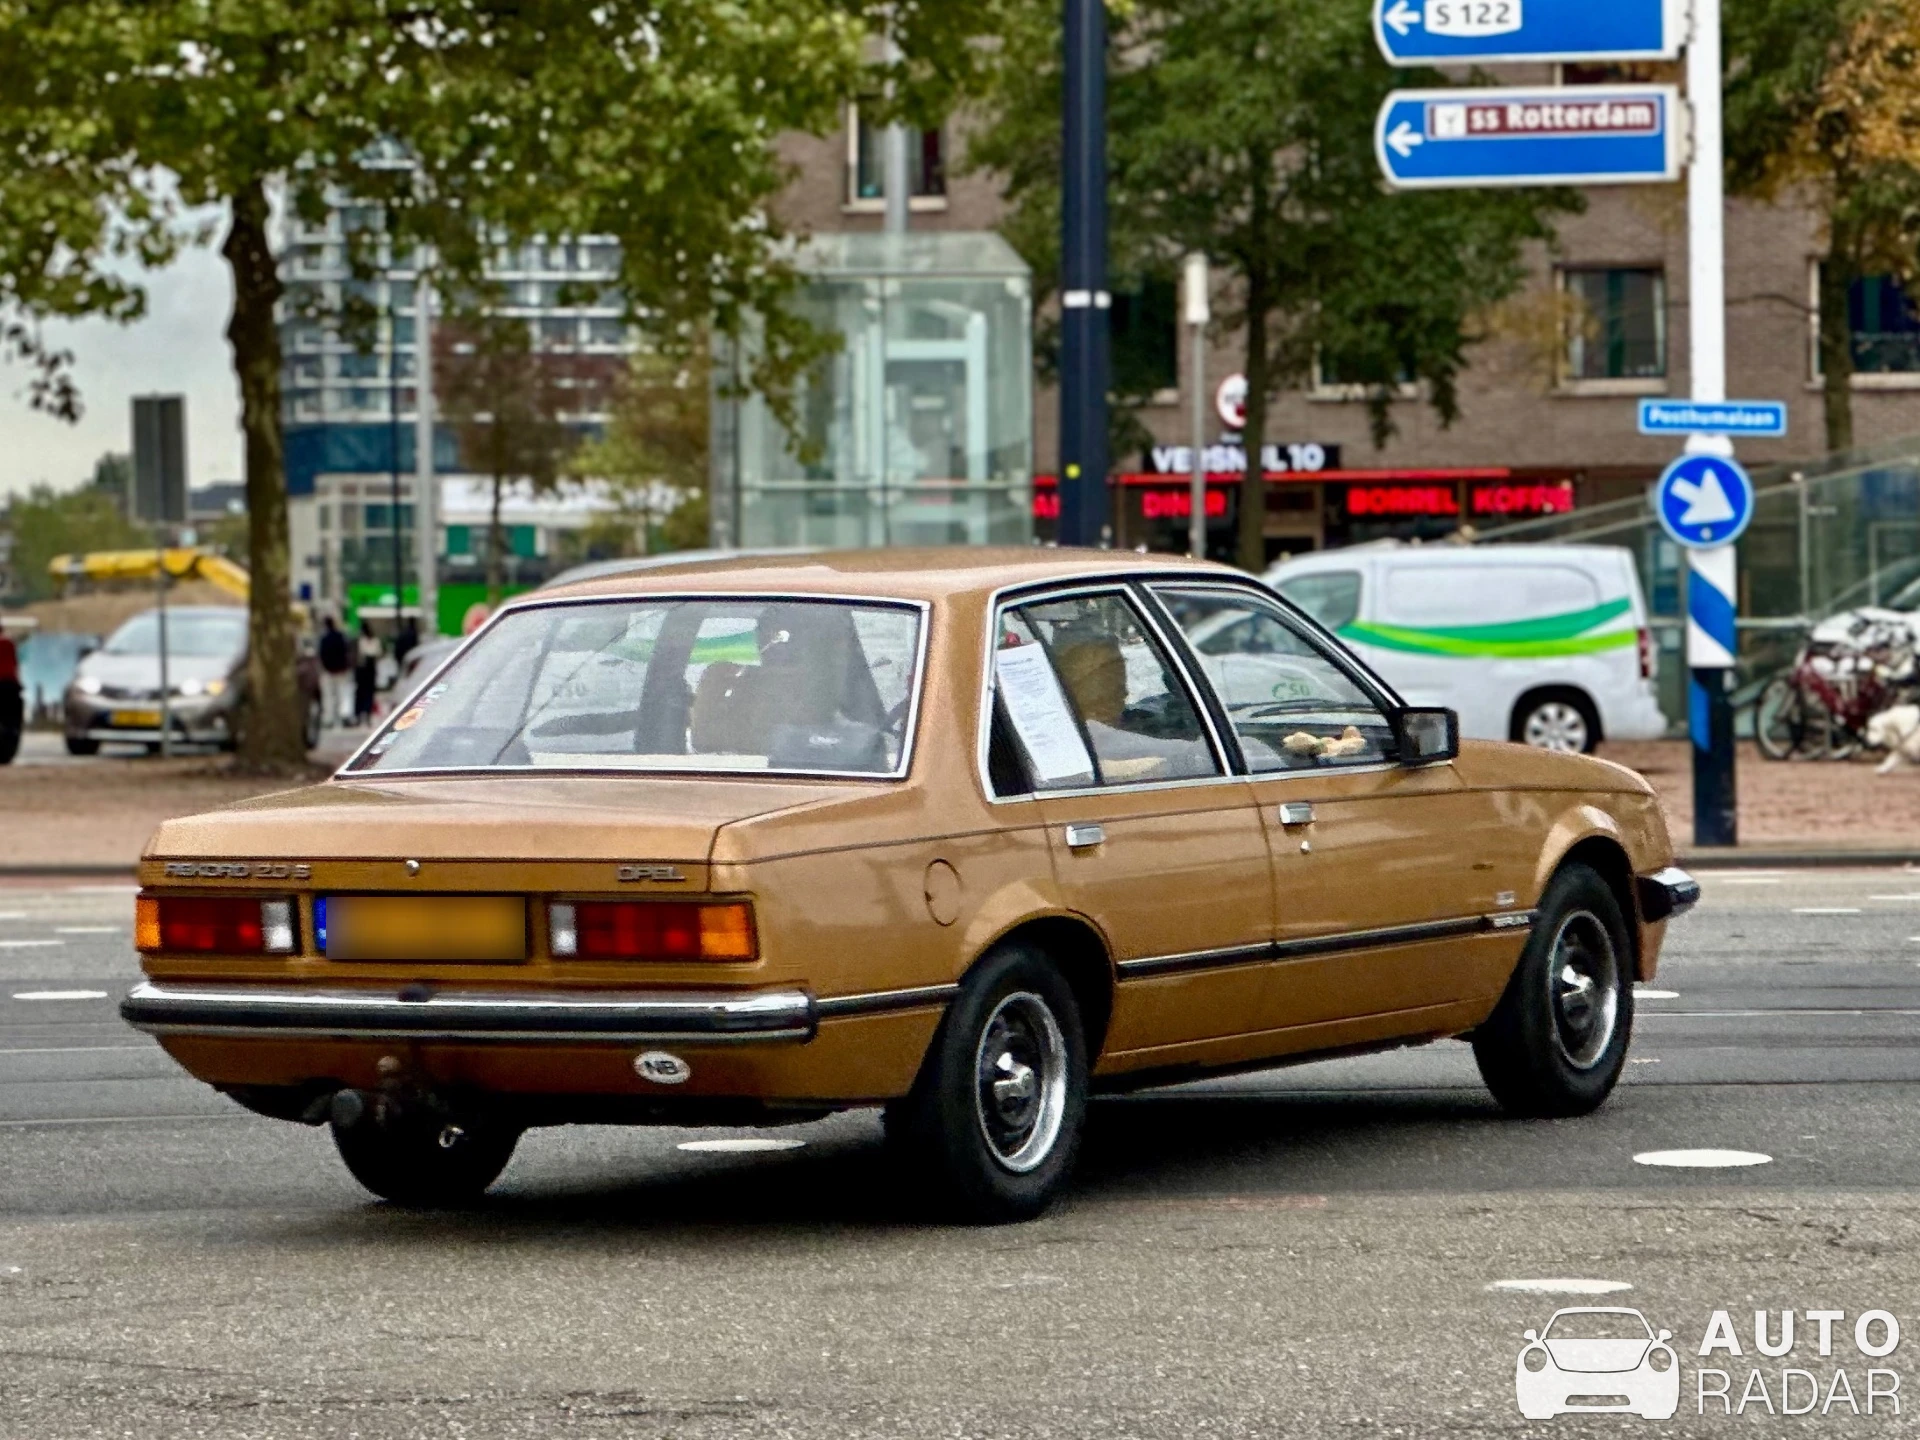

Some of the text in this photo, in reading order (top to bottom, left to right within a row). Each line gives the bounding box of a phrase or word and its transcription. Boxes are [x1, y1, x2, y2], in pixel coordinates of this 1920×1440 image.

[1436, 2, 1511, 27] S 122
[1469, 102, 1652, 130] ss Rotterdam
[1151, 445, 1288, 474] VESNL
[1142, 491, 1226, 518] DINR
[617, 865, 686, 881] OPEL
